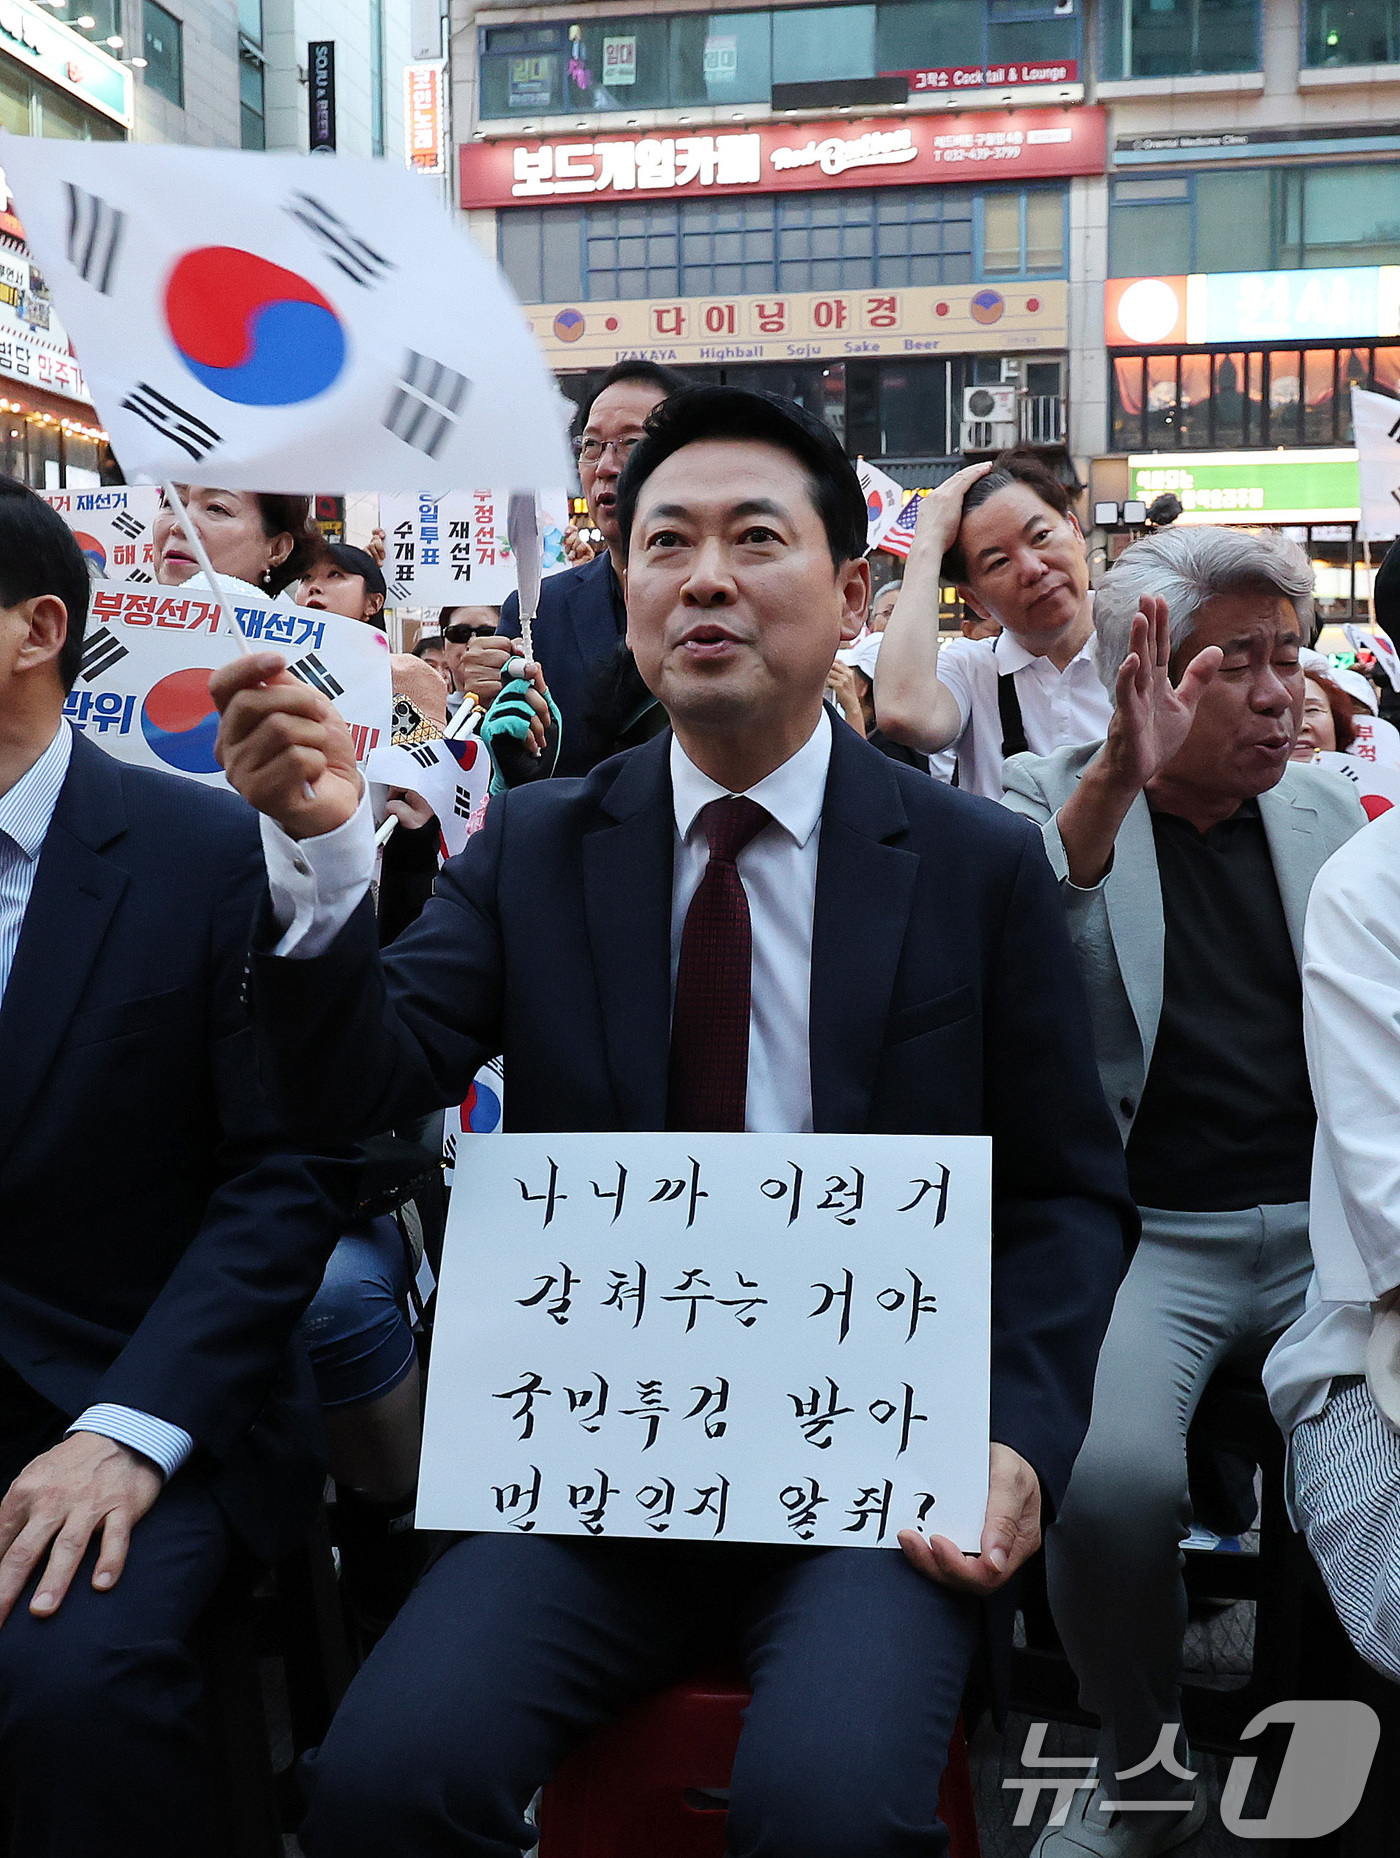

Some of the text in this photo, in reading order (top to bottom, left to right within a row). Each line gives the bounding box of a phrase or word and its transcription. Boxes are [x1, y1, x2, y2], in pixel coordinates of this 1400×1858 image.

[606, 44, 635, 65] 임대
[1022, 66, 1067, 81] Lounge
[511, 133, 760, 196] 보드게임카페
[814, 296, 897, 328] 야경
[615, 337, 940, 362] IZAKAYA Highball Soju Sake Beer
[76, 493, 128, 511] 재선거
[394, 520, 415, 582] 수개표
[449, 521, 472, 581] 재선거
[92, 591, 326, 650] 부정선거 재선거
[514, 1155, 951, 1230] 나니까 이런 거
[808, 1267, 938, 1345] 거야
[491, 1371, 731, 1453] 국민특검
